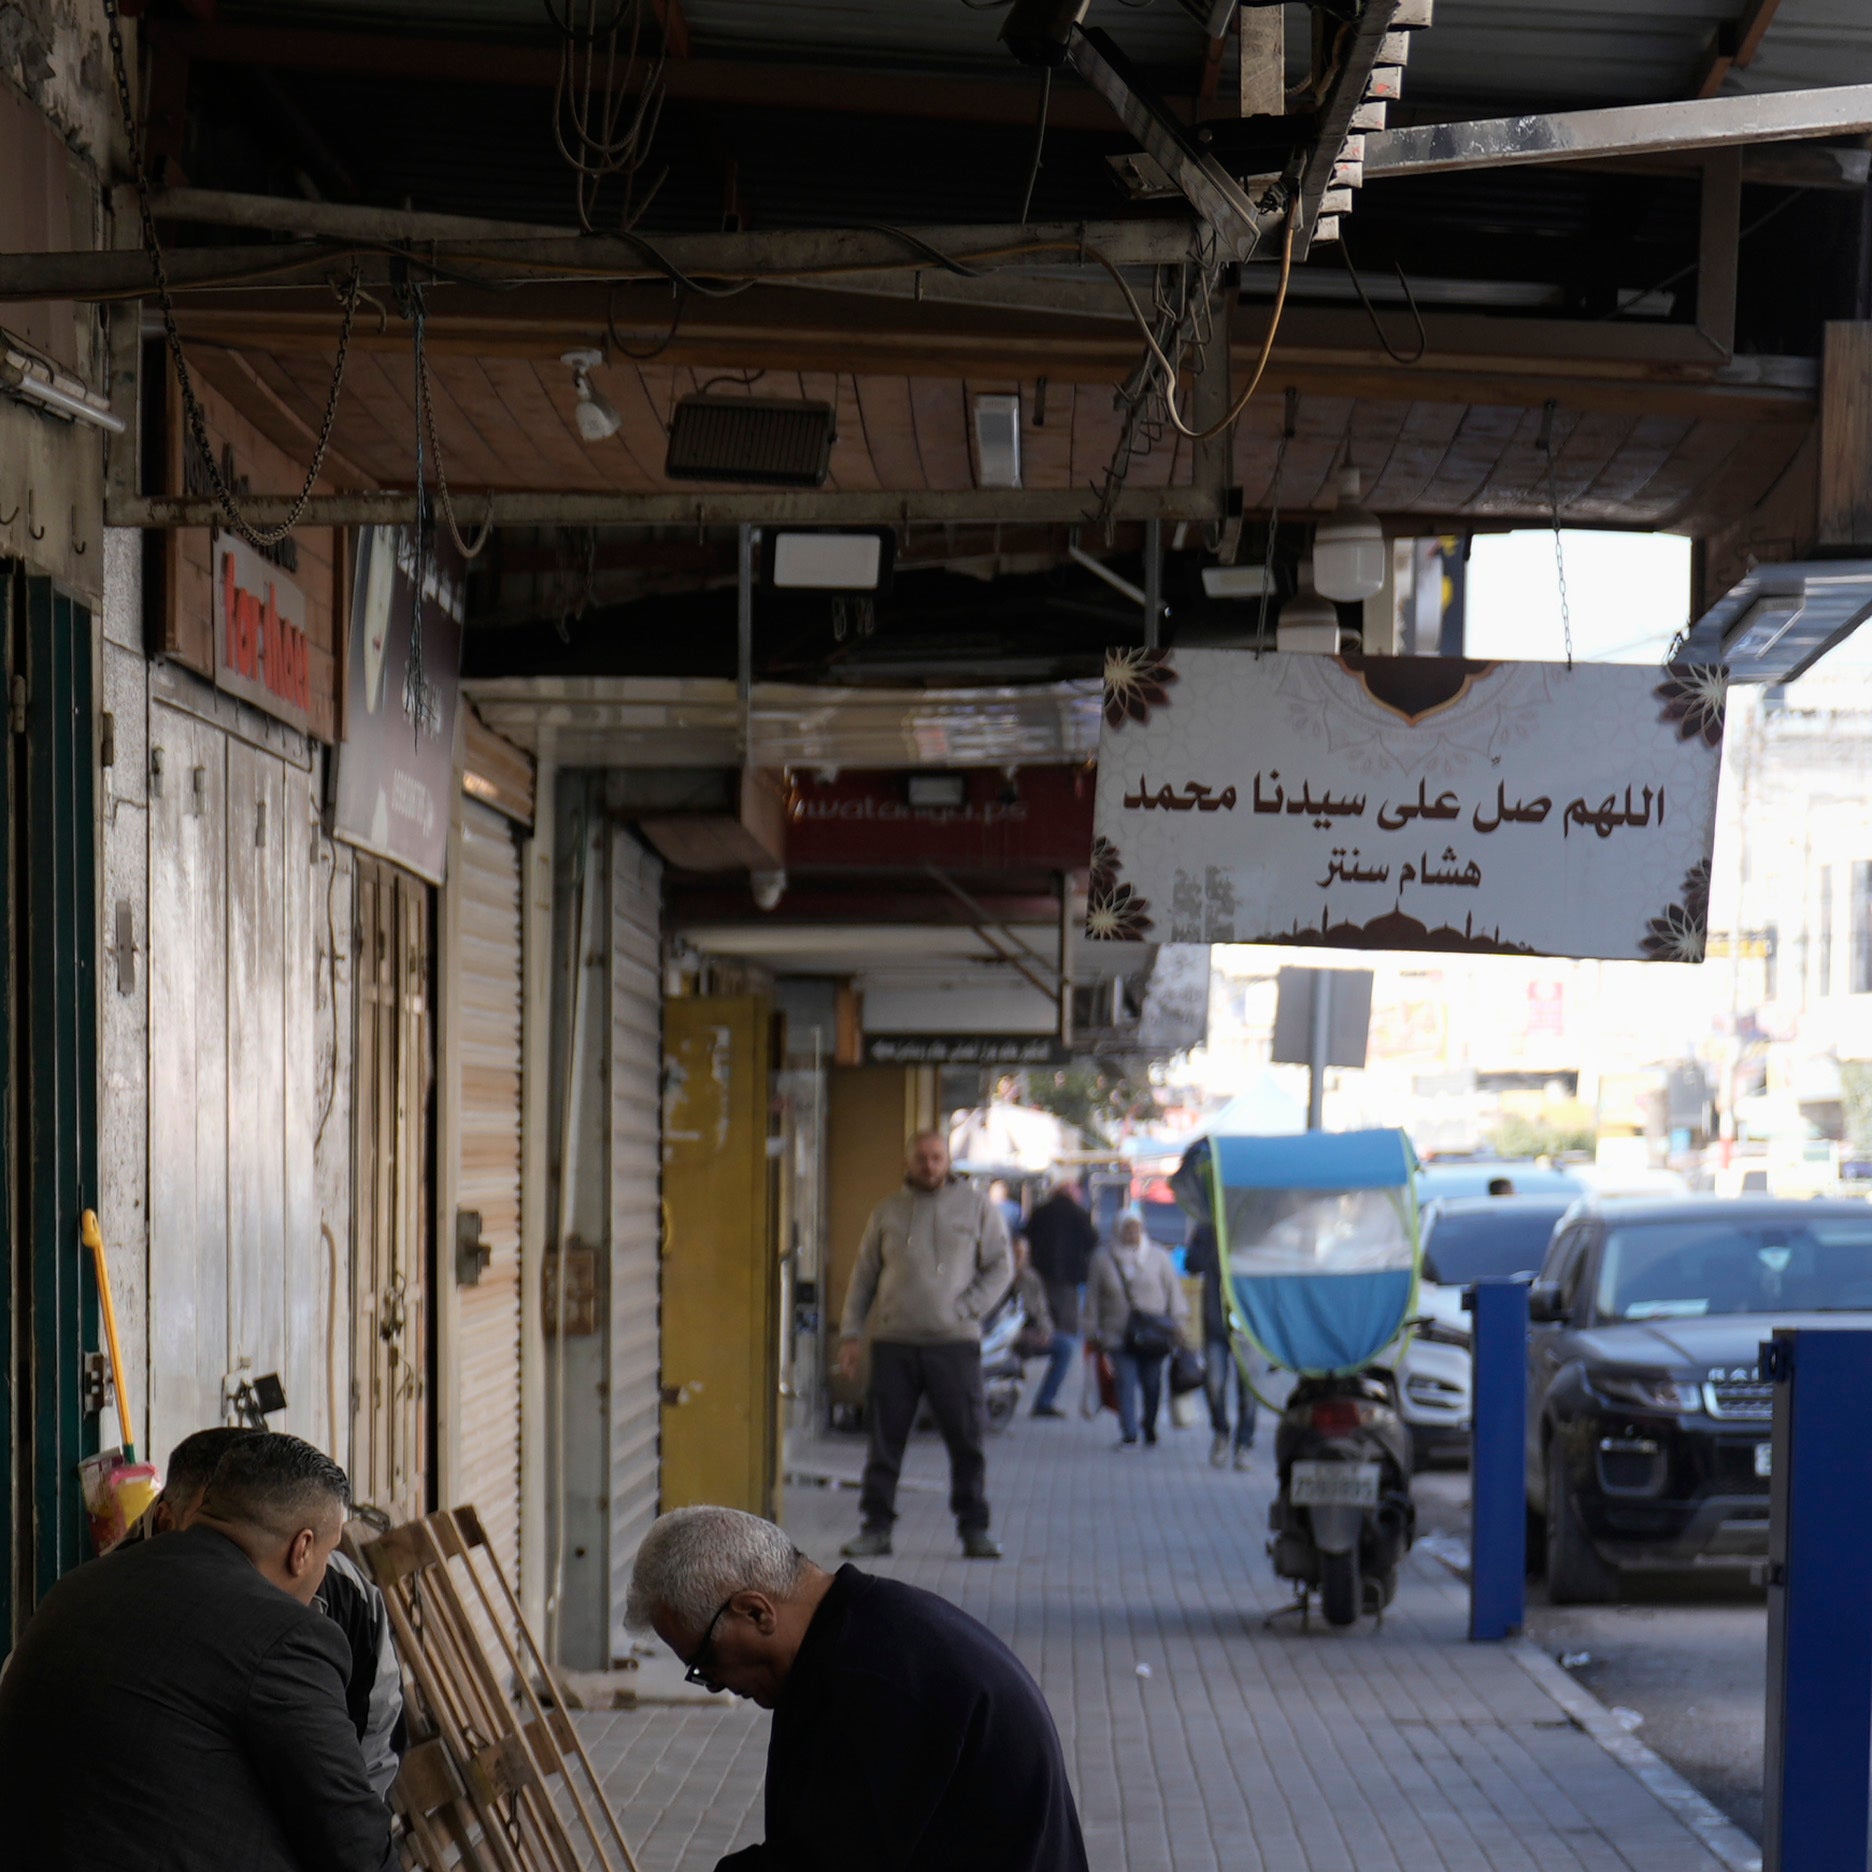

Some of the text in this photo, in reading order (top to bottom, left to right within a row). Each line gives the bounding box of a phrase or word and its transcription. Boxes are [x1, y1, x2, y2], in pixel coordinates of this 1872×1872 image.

[1123, 773, 1238, 813] محمد
[1253, 769, 1367, 830] سيدنا
[1376, 777, 1460, 830] على
[1562, 784, 1666, 839] اللهم
[1316, 846, 1483, 894] هشام سنتر
